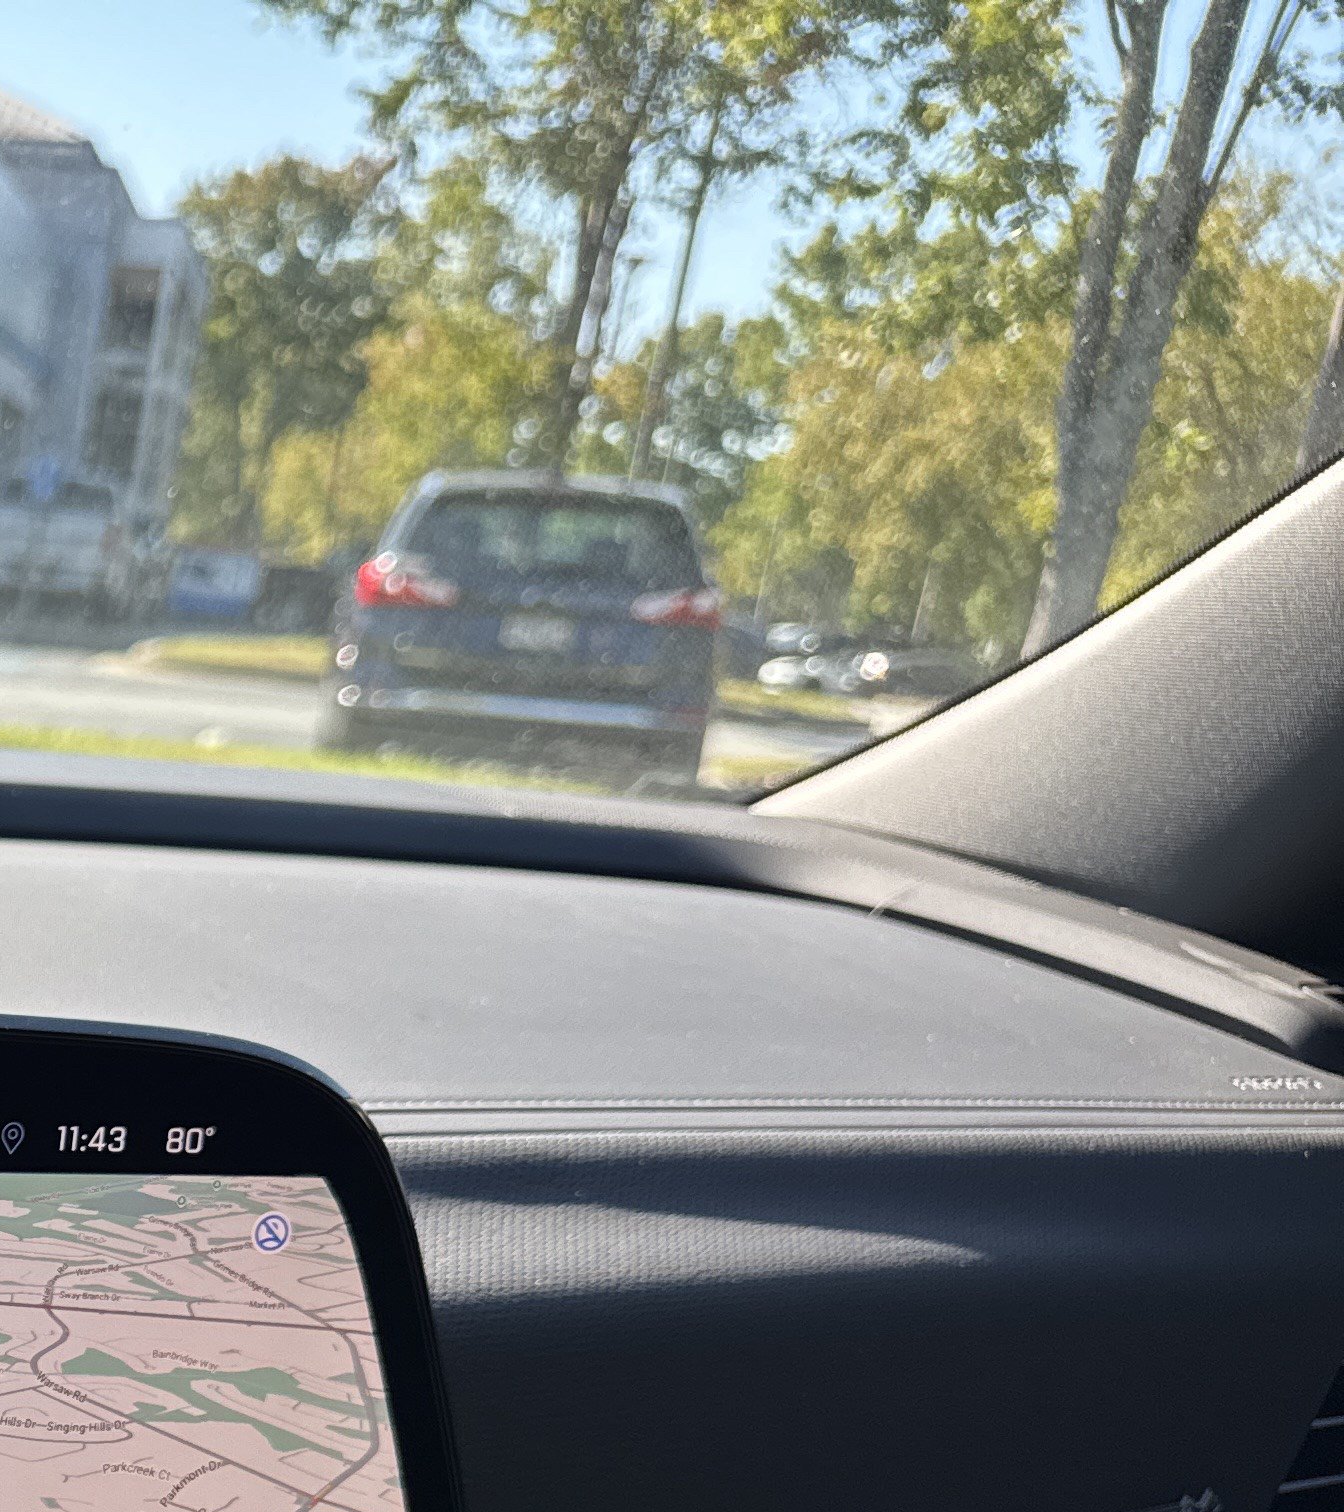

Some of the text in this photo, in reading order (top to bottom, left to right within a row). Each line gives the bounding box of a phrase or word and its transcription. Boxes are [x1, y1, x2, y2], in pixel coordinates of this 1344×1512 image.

[57, 1125, 127, 1153] 11:43
[36, 1370, 87, 1402] Warsaw Rd
[0, 1416, 23, 1428] Hills
[24, 1419, 37, 1429] Dr
[46, 1421, 87, 1435] Singing
[102, 1462, 171, 1481] Parkcreek Ct
[159, 1460, 224, 1507] Parkmont Dr
